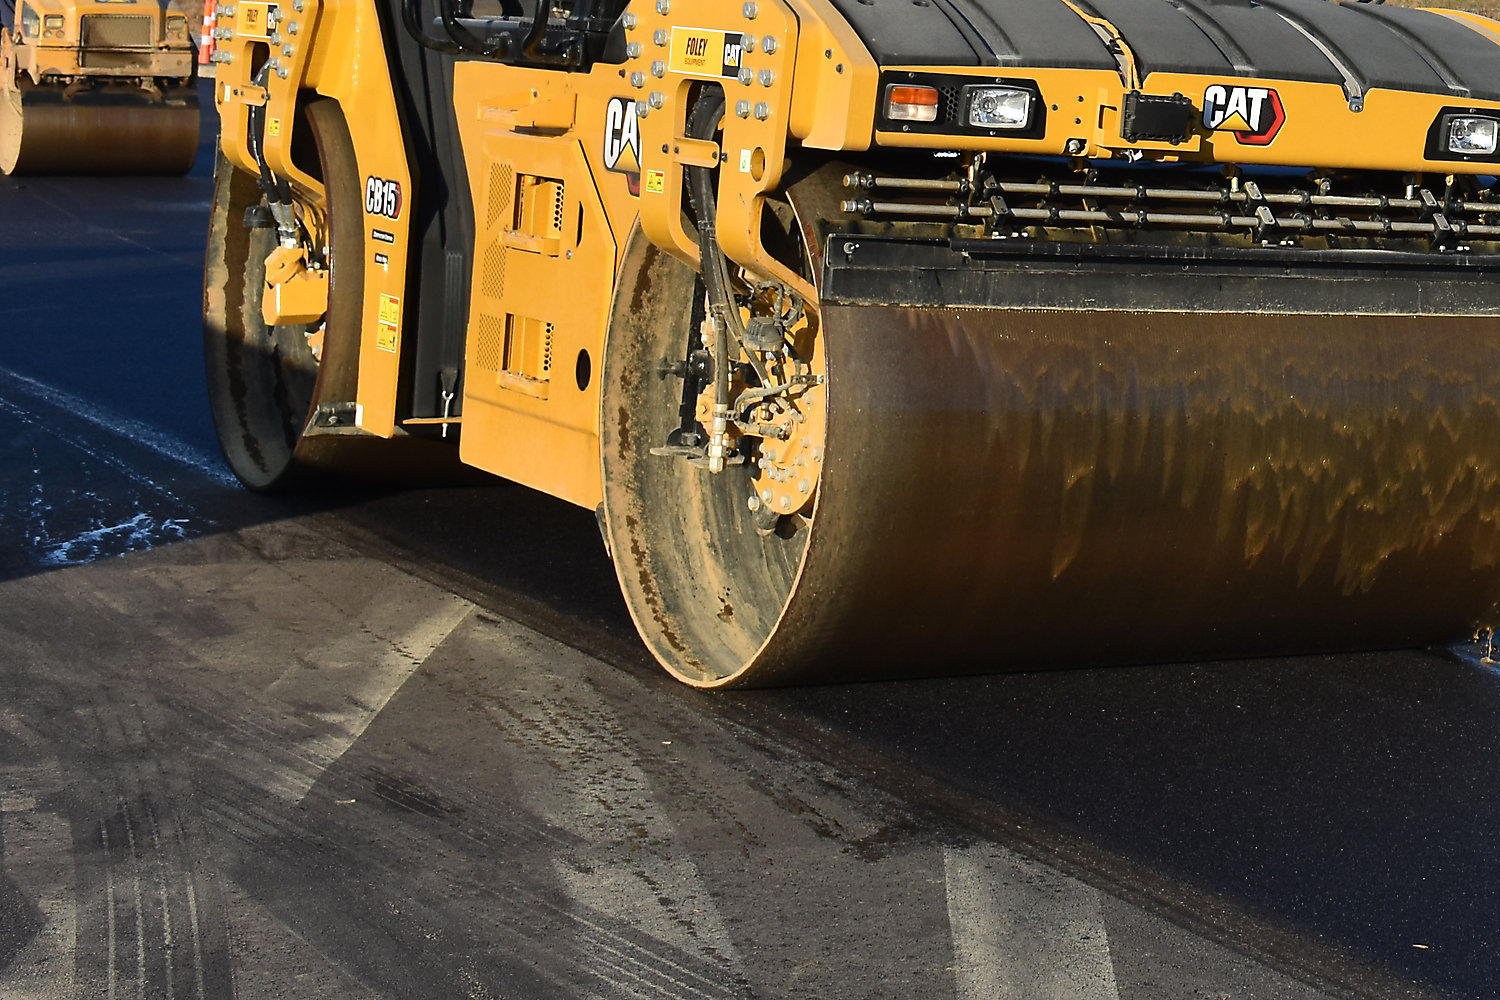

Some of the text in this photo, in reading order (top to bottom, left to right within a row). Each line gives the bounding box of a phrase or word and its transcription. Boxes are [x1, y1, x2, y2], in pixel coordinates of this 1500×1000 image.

[685, 37, 708, 57] FOLEY
[724, 43, 741, 67] CAT
[1203, 85, 1268, 132] CAT
[604, 98, 642, 169] CA
[366, 177, 396, 217] CB15
